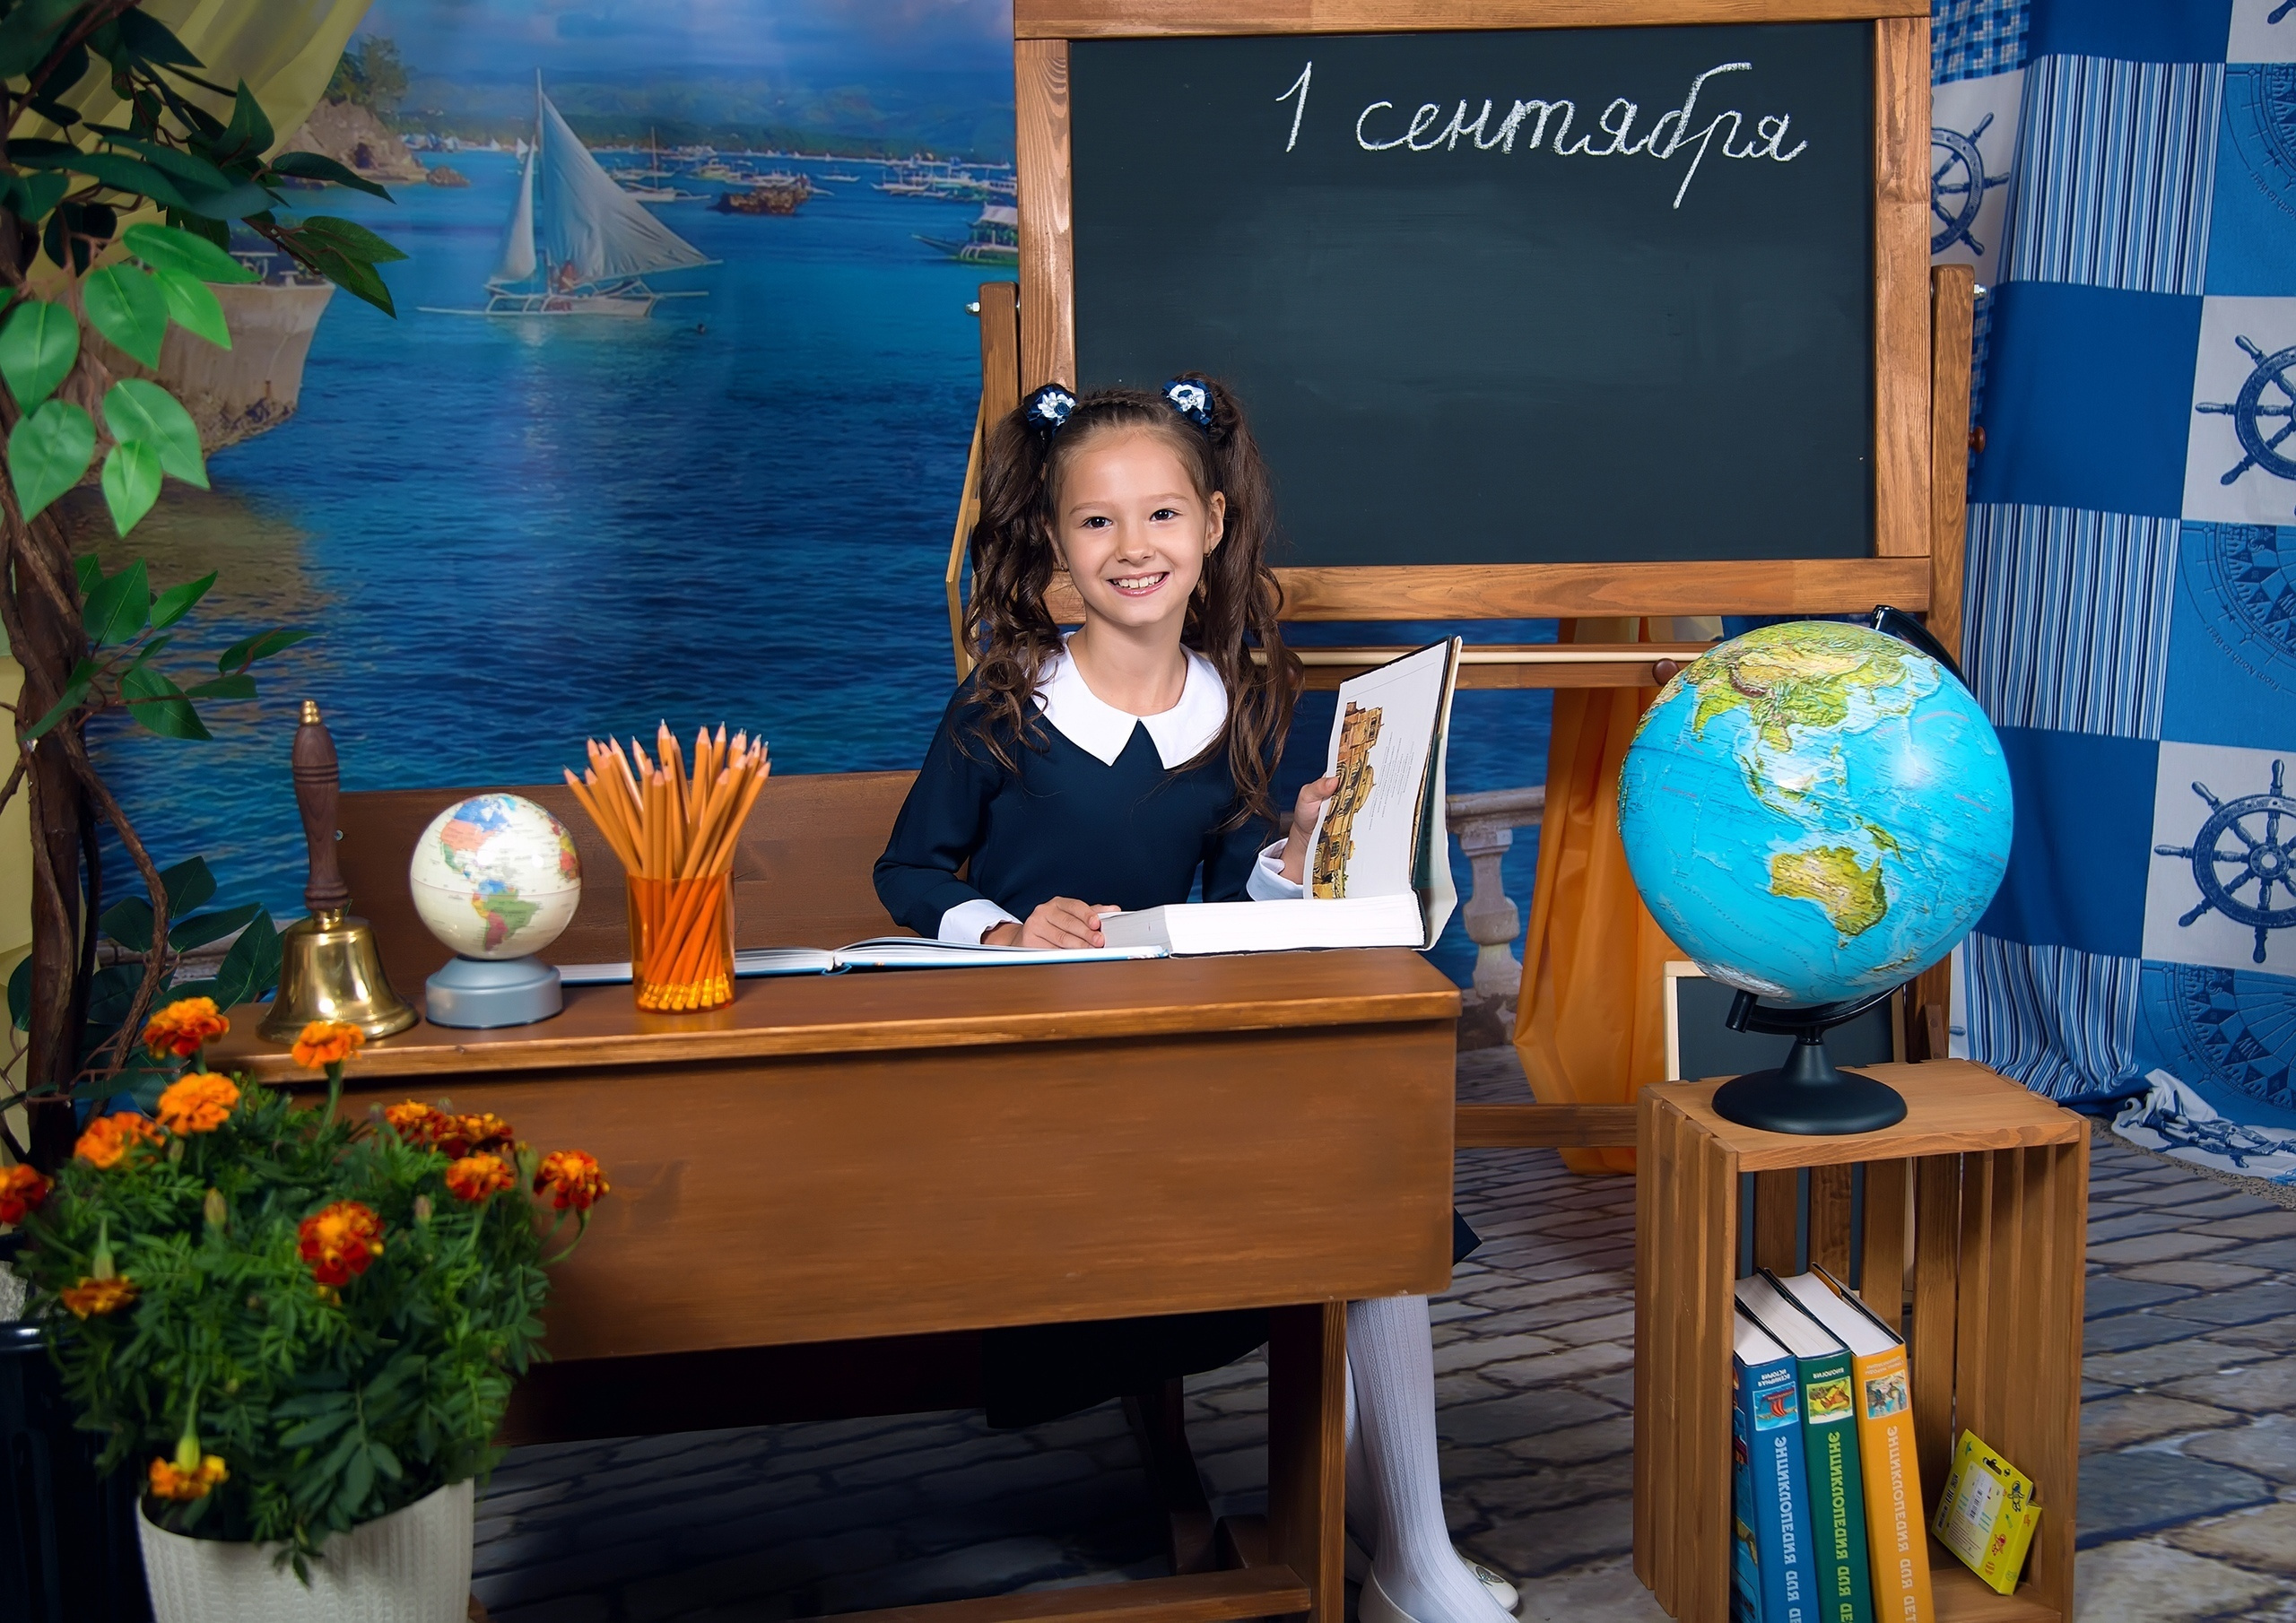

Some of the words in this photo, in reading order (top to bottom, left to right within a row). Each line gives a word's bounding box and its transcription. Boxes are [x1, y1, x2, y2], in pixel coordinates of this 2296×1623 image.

[1276, 61, 1311, 152] 1
[1355, 61, 1808, 209] сентября
[2232, 653, 2257, 675] North
[1774, 1436, 1796, 1565] ЭНЦИКЛОПЕДИЯ
[1785, 1570, 1800, 1601] ДЛЯ
[1828, 1431, 1848, 1560] ЭНЦИКЛОПЕДИЯ
[1887, 1426, 1909, 1552] ЭНЦИКЛОПЕДИЯ
[1900, 1558, 1913, 1589] ДЛЯ
[1837, 1566, 1851, 1596] ДЛЯ
[1839, 1603, 1854, 1623] ДЕ
